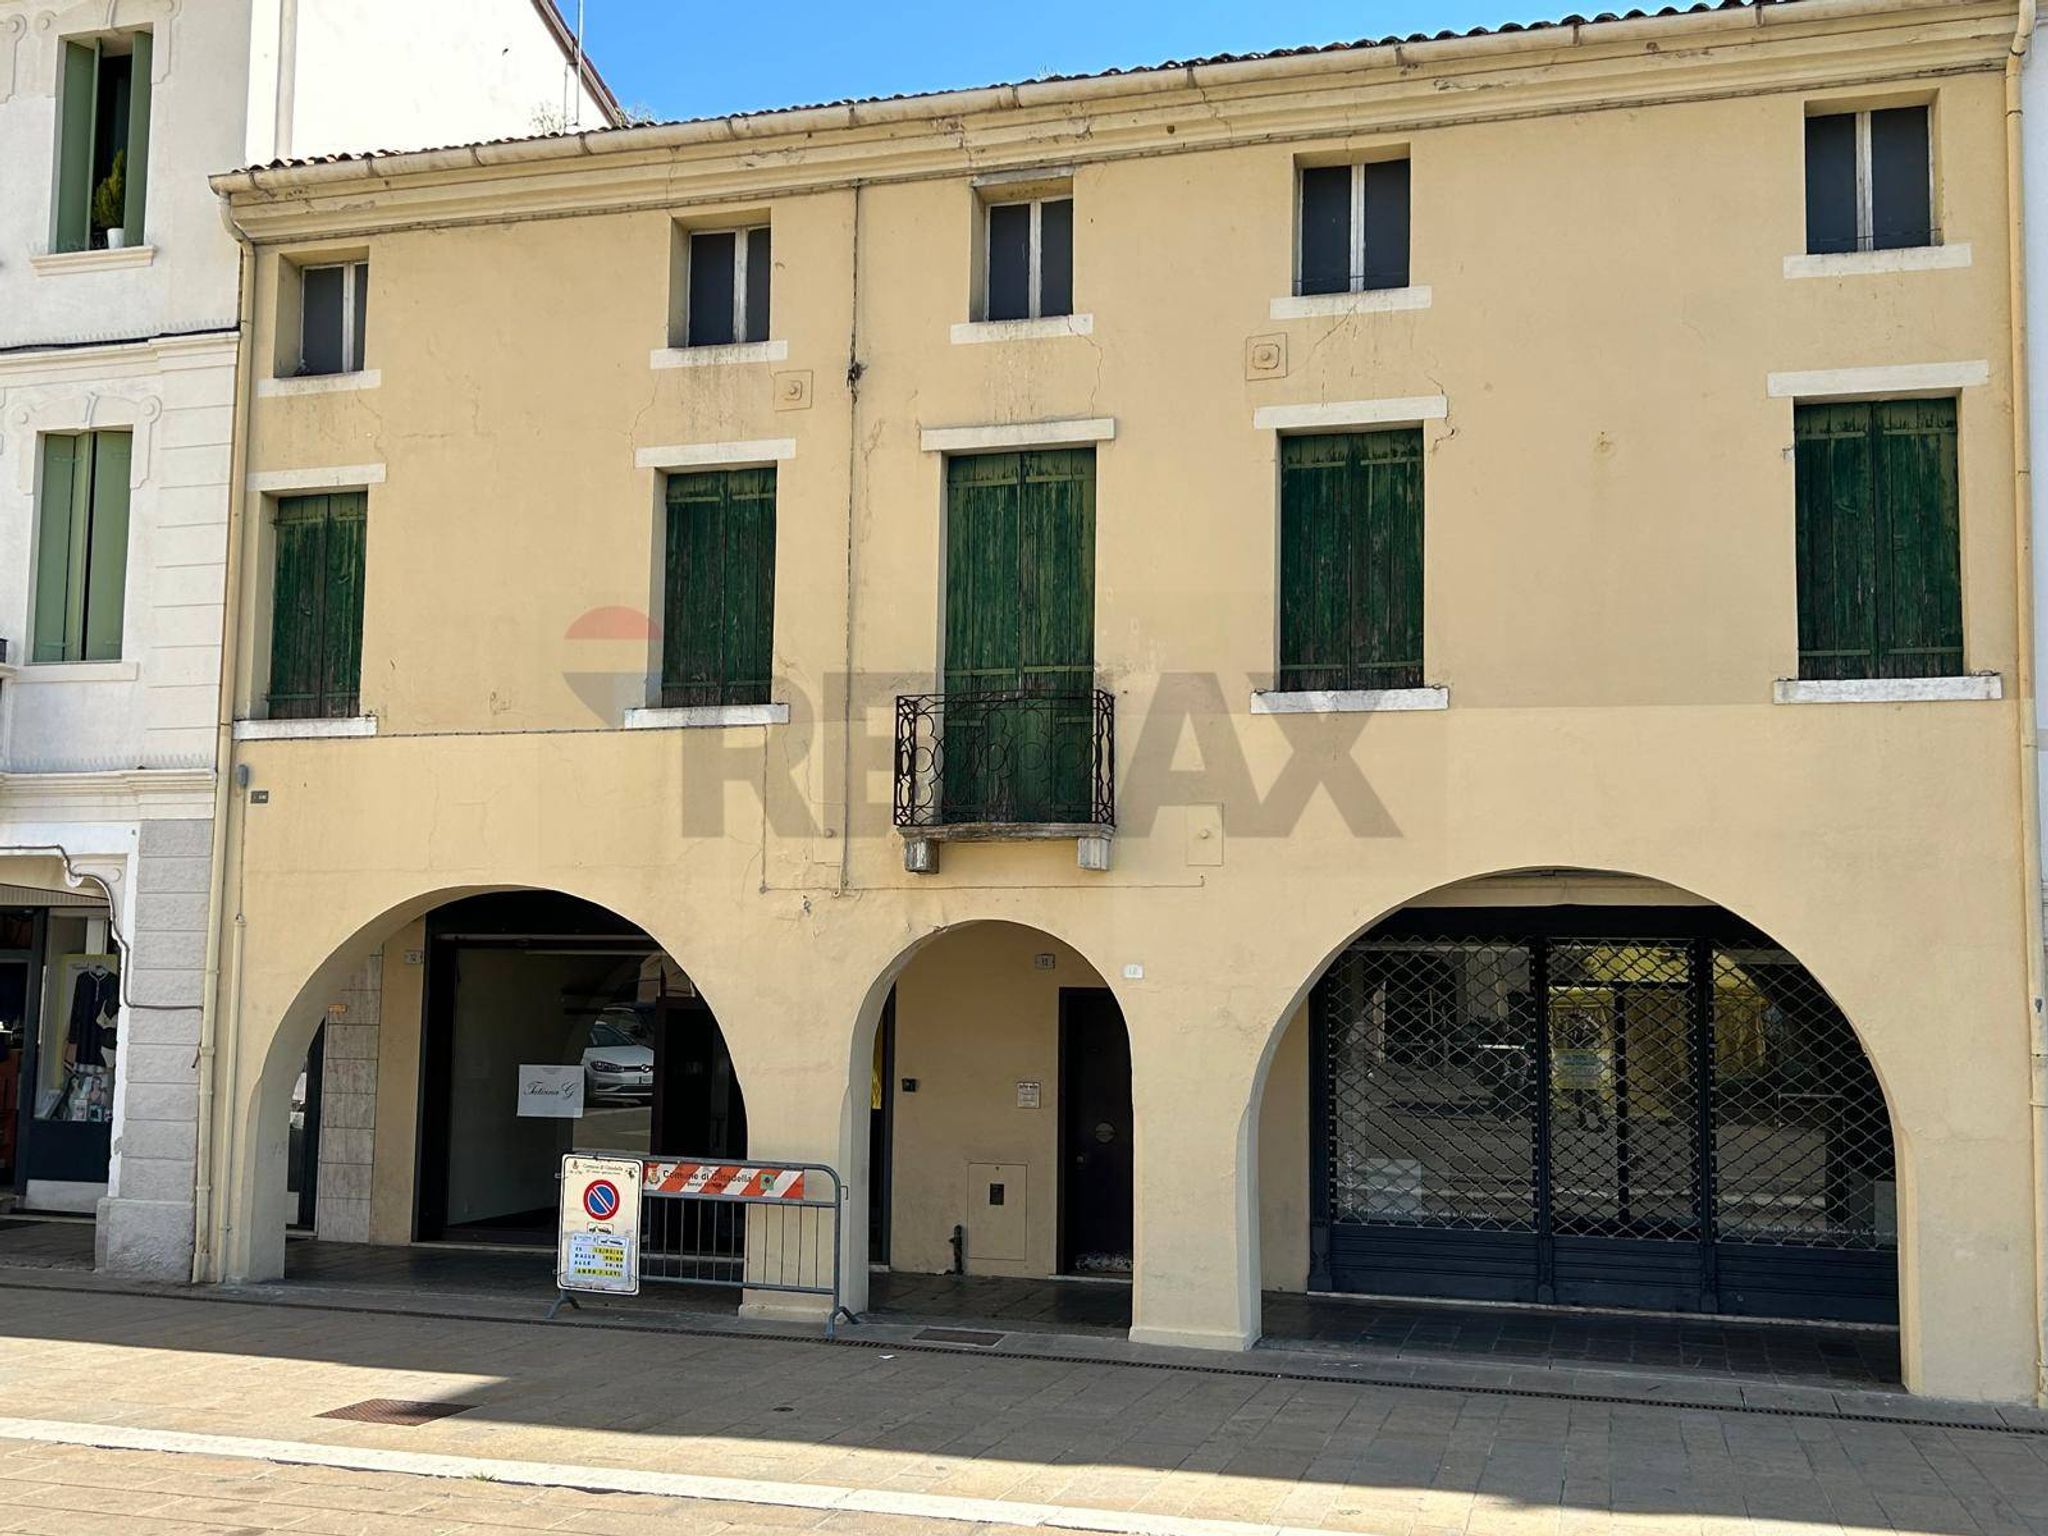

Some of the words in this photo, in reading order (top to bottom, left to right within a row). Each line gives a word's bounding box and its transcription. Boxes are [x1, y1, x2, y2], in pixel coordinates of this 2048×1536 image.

[663, 1169, 699, 1181] Comune
[701, 1172, 710, 1181] di
[711, 1173, 752, 1183] Cittadella
